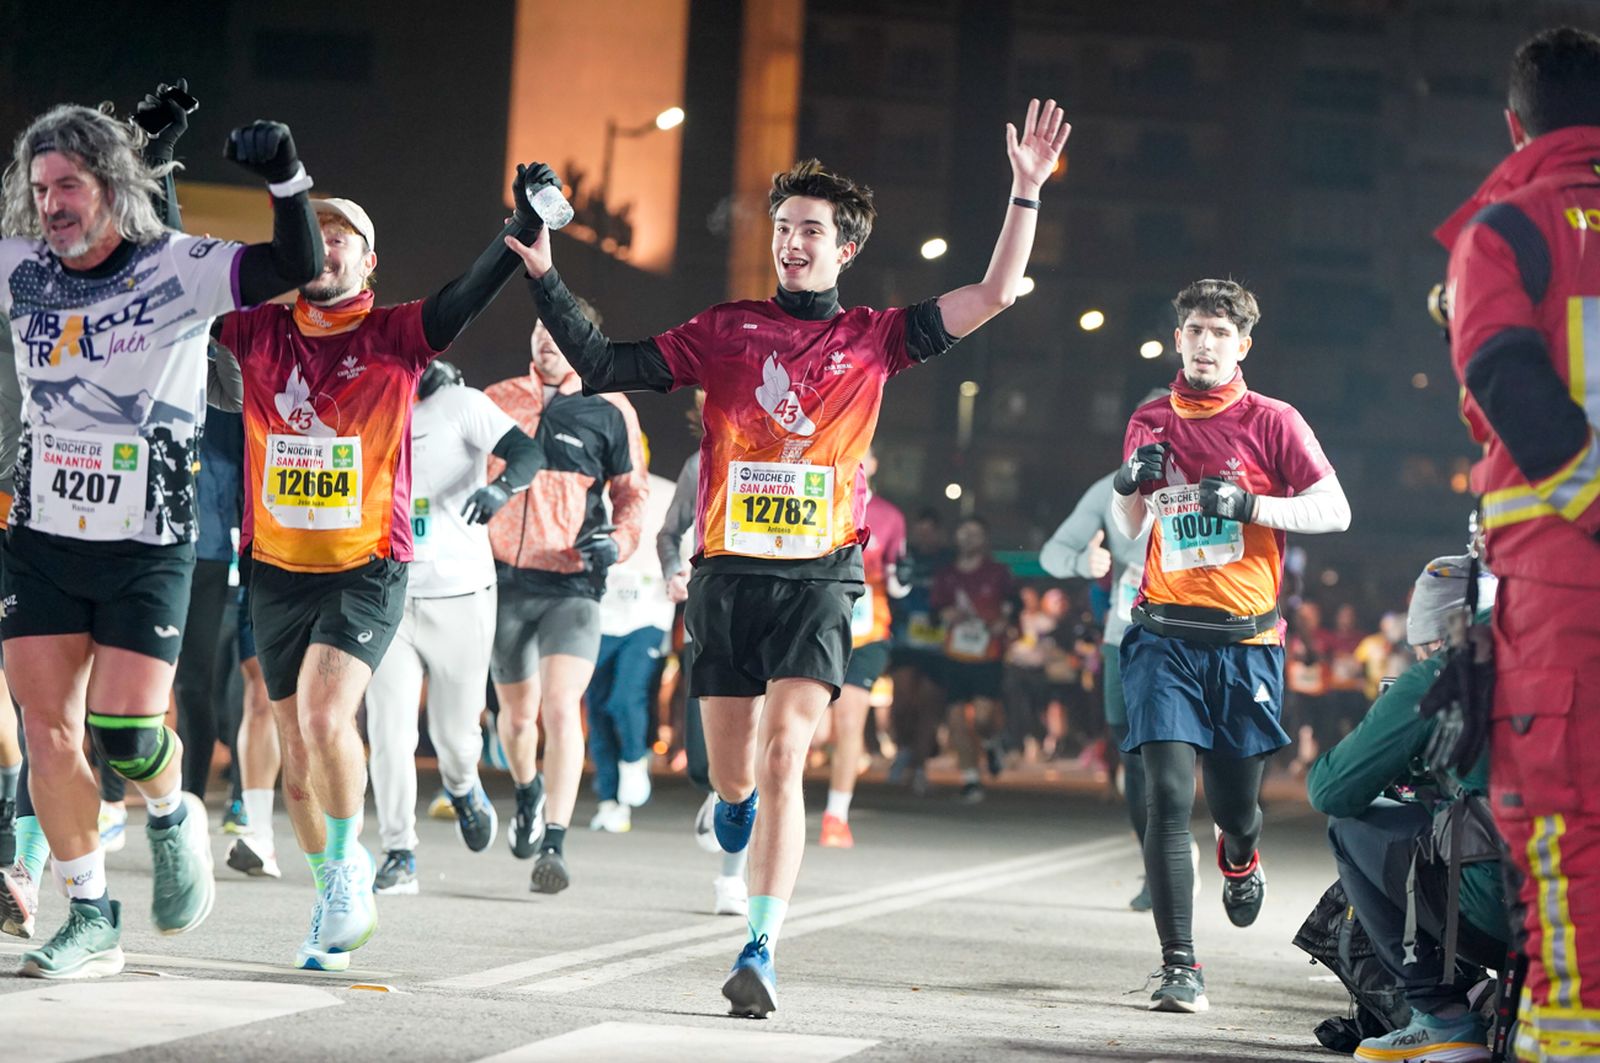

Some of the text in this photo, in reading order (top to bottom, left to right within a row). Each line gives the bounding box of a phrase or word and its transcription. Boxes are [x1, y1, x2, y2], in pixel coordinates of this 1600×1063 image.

[26, 331, 151, 368] TRAIL Jaén
[288, 408, 314, 430] 43
[773, 399, 799, 424] 43
[56, 442, 102, 456] NOCHE DE
[43, 452, 63, 465] SAN
[65, 456, 102, 470] ANTÓN
[276, 457, 294, 467] SAN
[52, 468, 122, 504] 4207
[276, 469, 349, 498] 12664
[740, 483, 760, 494] SAN
[761, 483, 795, 495] ANTÓN
[752, 473, 797, 483] NOCHE DE
[743, 496, 817, 526] 12782
[767, 526, 791, 534] Antonio
[1172, 514, 1223, 541] 9007
